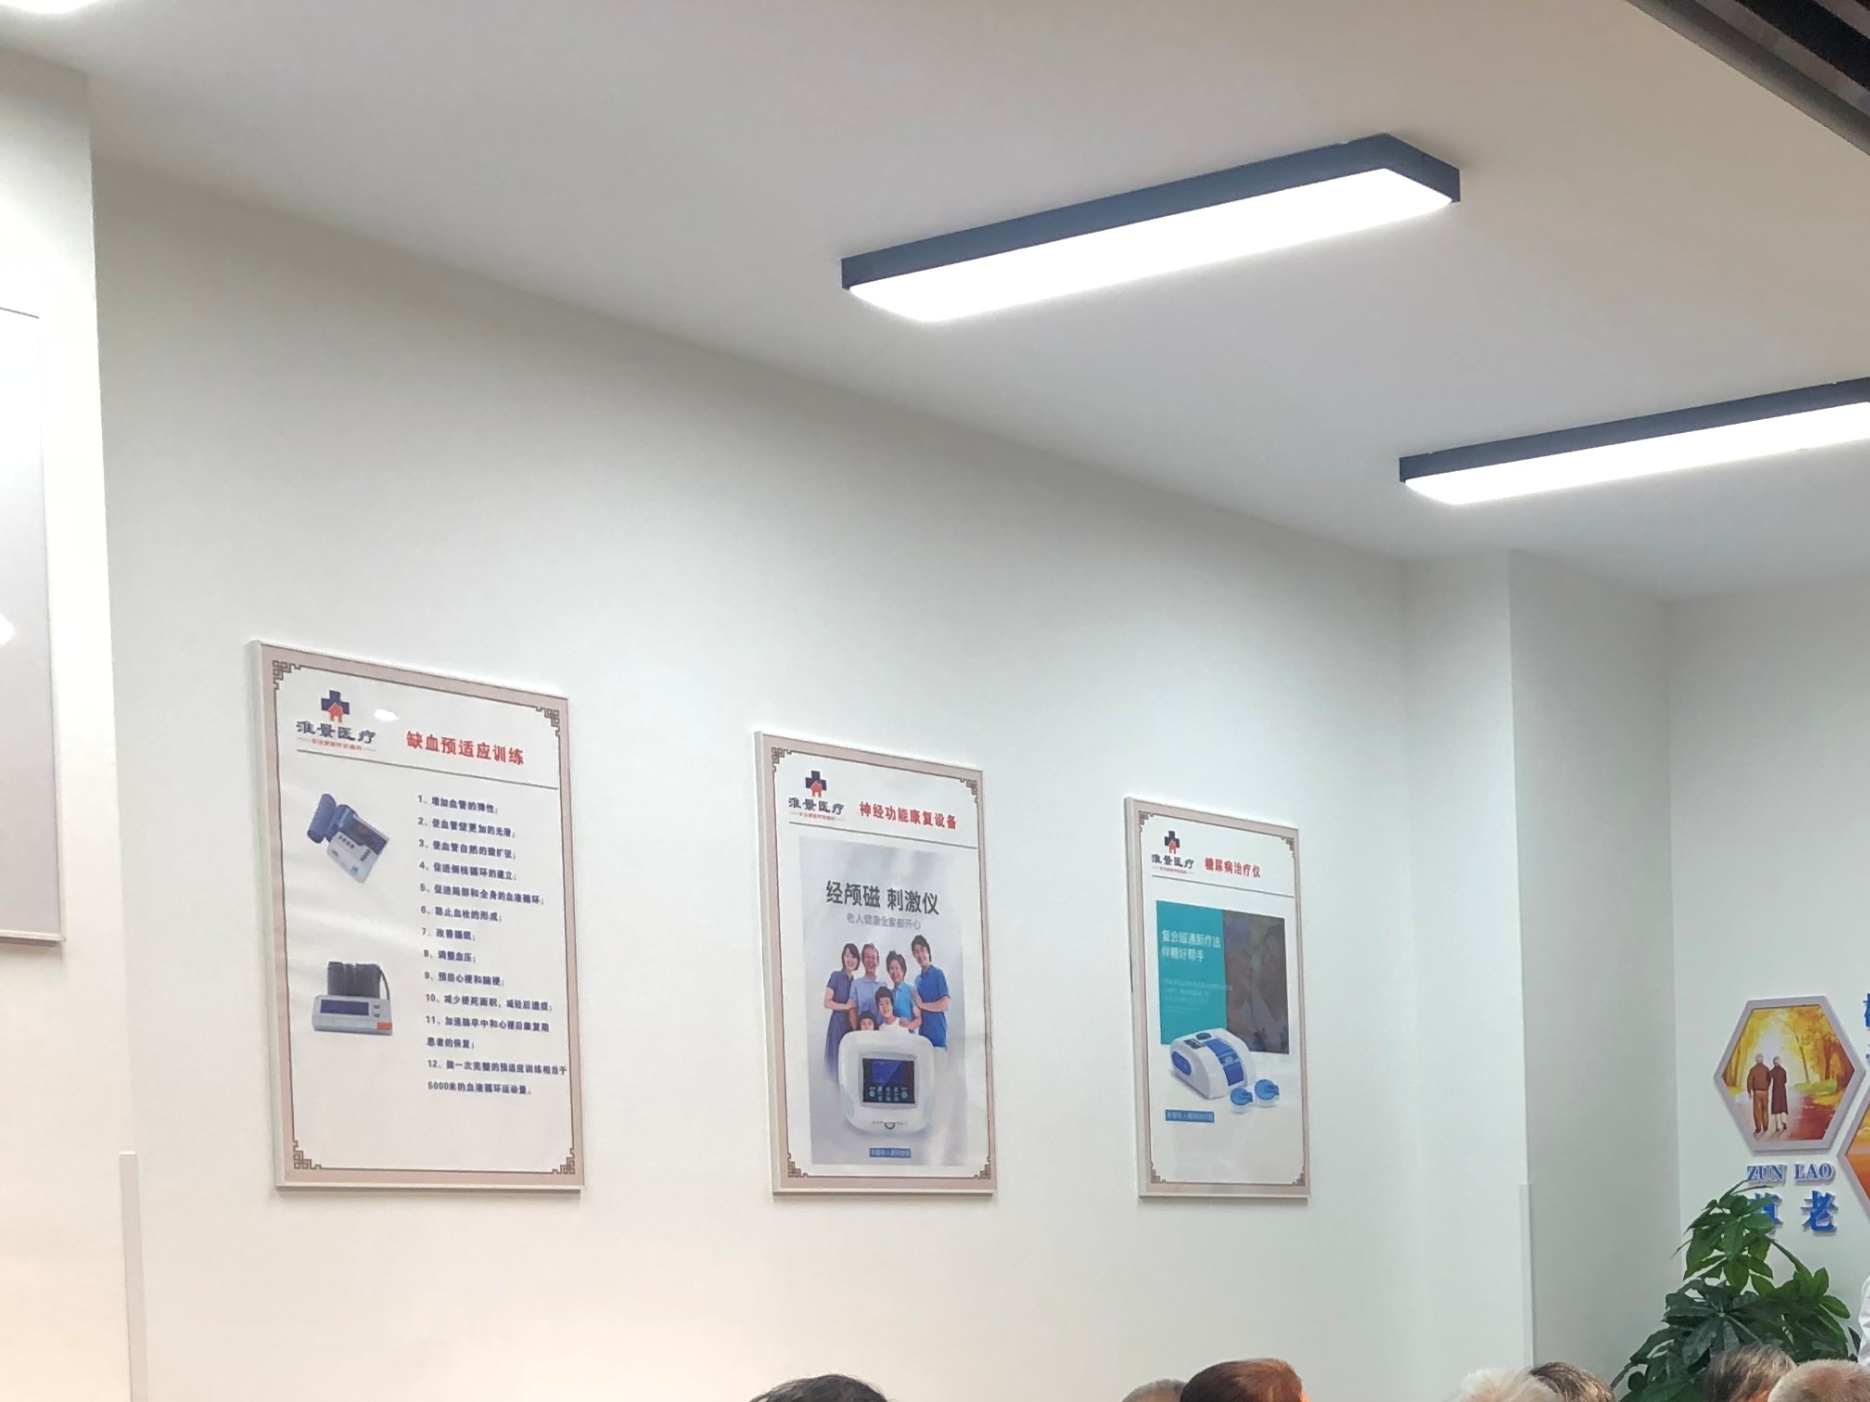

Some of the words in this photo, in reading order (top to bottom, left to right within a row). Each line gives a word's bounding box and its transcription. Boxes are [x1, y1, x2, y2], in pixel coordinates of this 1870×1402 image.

[406, 731, 525, 766] 缺血预适应训练
[859, 801, 957, 830] 神经功能康复设备
[1204, 857, 1261, 878] 糖尿病治疗仪
[826, 880, 881, 908] 经颅磁
[887, 888, 939, 915] 刺激仪
[1747, 1164, 1786, 1182] ZUN
[1794, 1163, 1834, 1182] LAO
